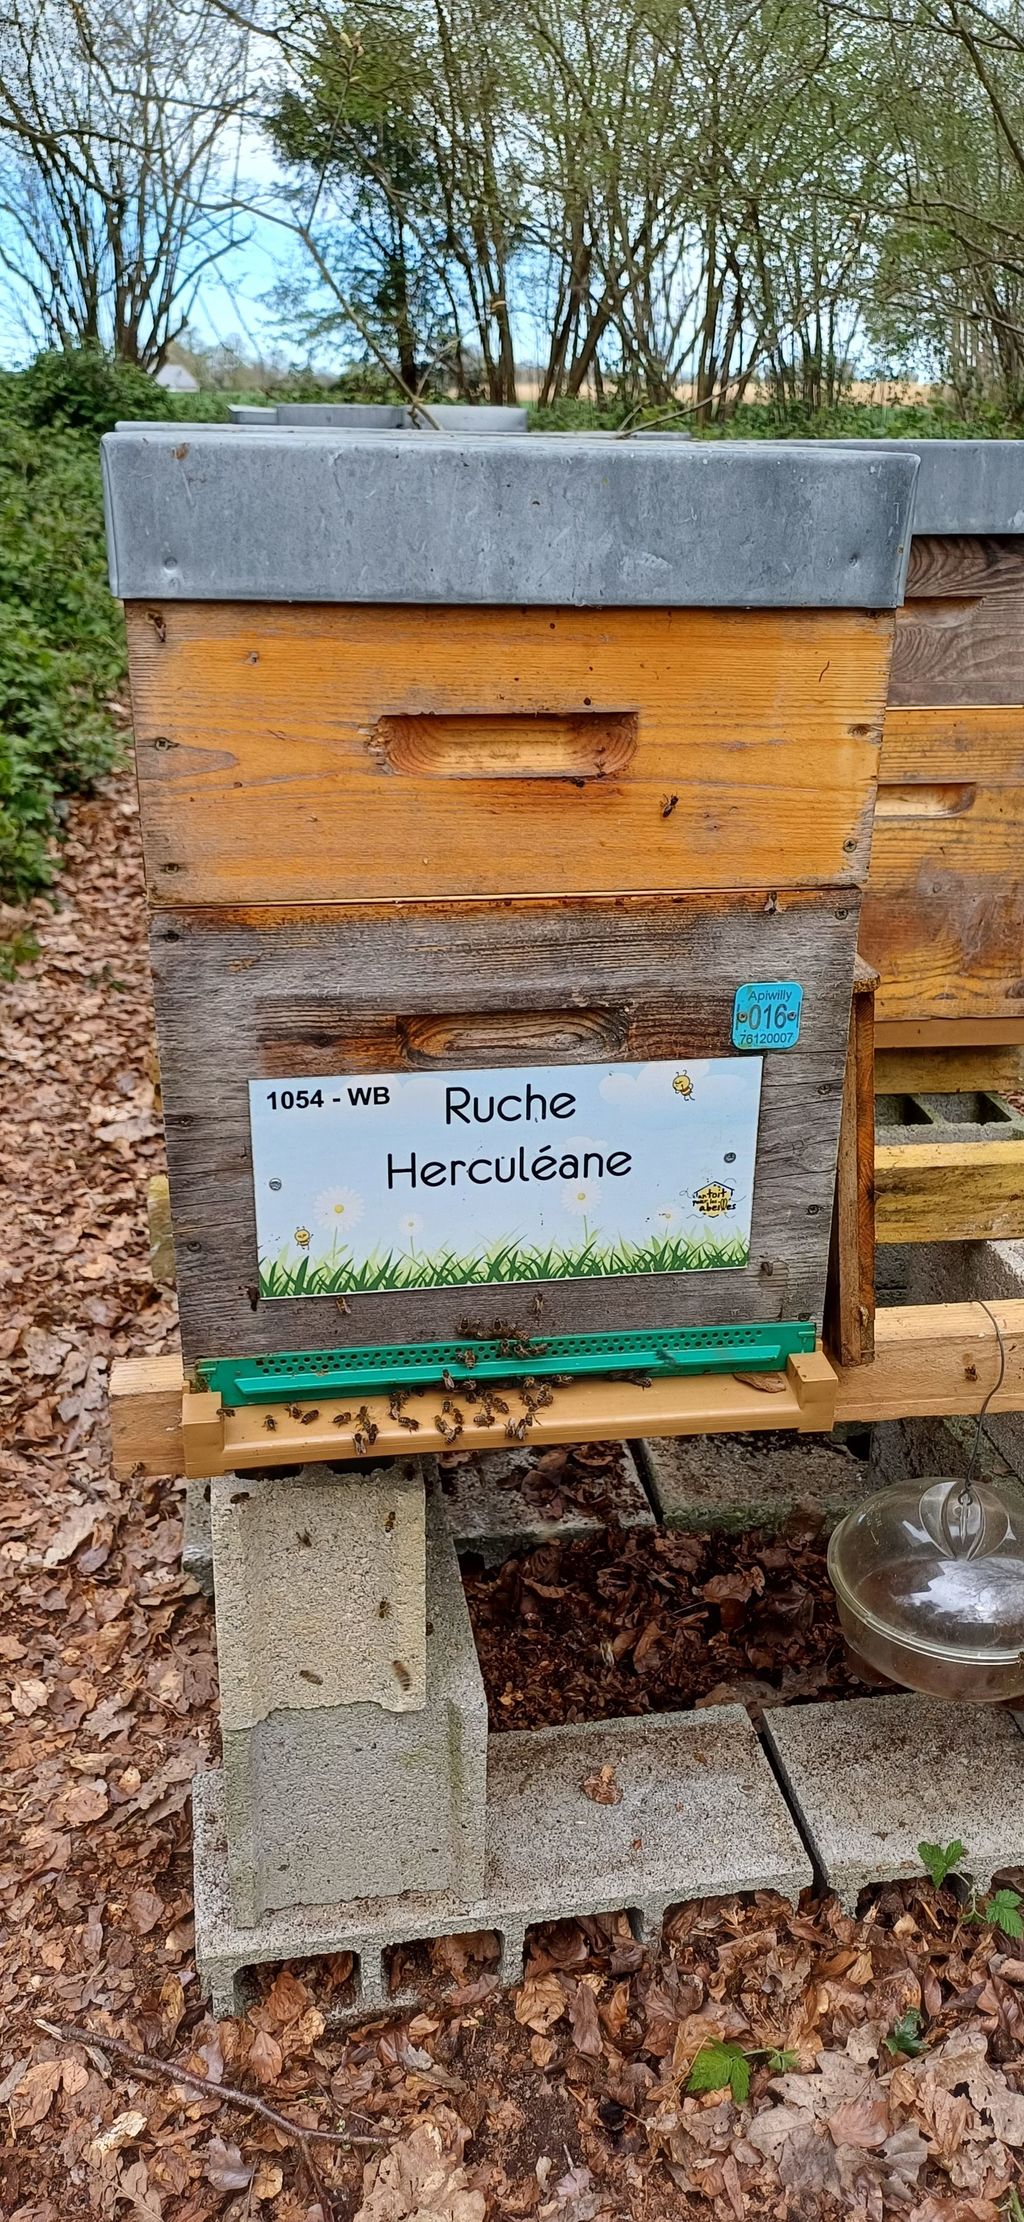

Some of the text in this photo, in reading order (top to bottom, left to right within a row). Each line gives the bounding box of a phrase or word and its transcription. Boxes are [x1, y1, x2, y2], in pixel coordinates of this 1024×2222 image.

[748, 989, 792, 1003] Apiwilly
[748, 1003, 788, 1031] 016
[740, 1032, 794, 1045] 76120007
[266, 1089, 324, 1110] 1054
[347, 1086, 391, 1106] WB
[445, 1083, 577, 1125] Ruche
[387, 1144, 633, 1190] Herculéane
[707, 1188, 727, 1198] toit
[699, 1200, 736, 1211] abeilles
